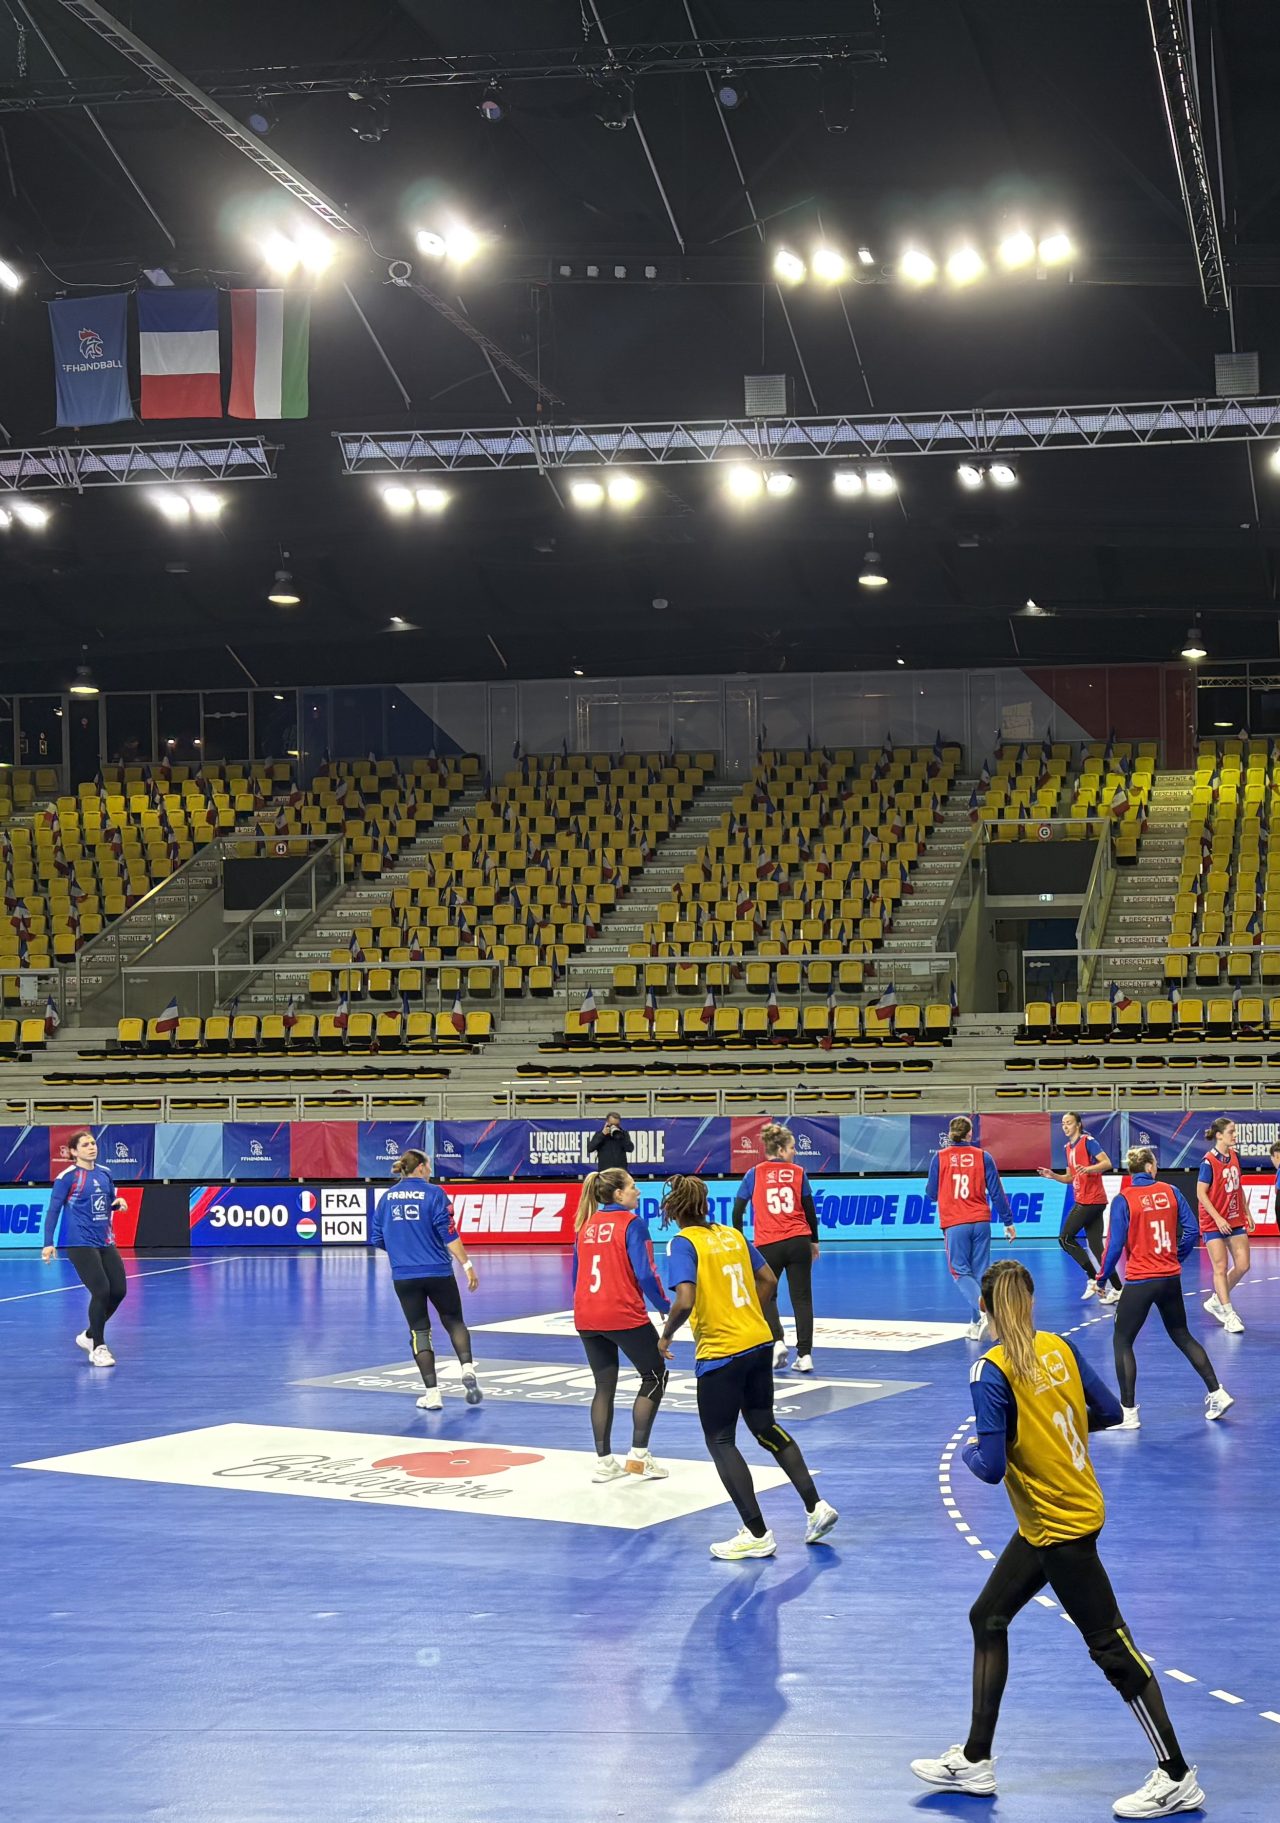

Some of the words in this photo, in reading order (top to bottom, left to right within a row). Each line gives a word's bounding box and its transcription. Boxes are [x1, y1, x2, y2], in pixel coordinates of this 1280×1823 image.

[1041, 828, 1048, 836] G
[277, 845, 285, 853] H
[529, 1131, 580, 1151] L'HISTOIRE
[1235, 1123, 1280, 1143] HISTOIRE
[952, 1174, 970, 1199] 78
[1222, 1166, 1240, 1193] 38
[326, 1194, 361, 1208] FRA
[766, 1187, 794, 1214] 53
[903, 1194, 937, 1224] DE
[209, 1205, 289, 1227] 30:00
[325, 1221, 362, 1235] HON
[1151, 1220, 1172, 1254] 34
[590, 1255, 602, 1293] 5
